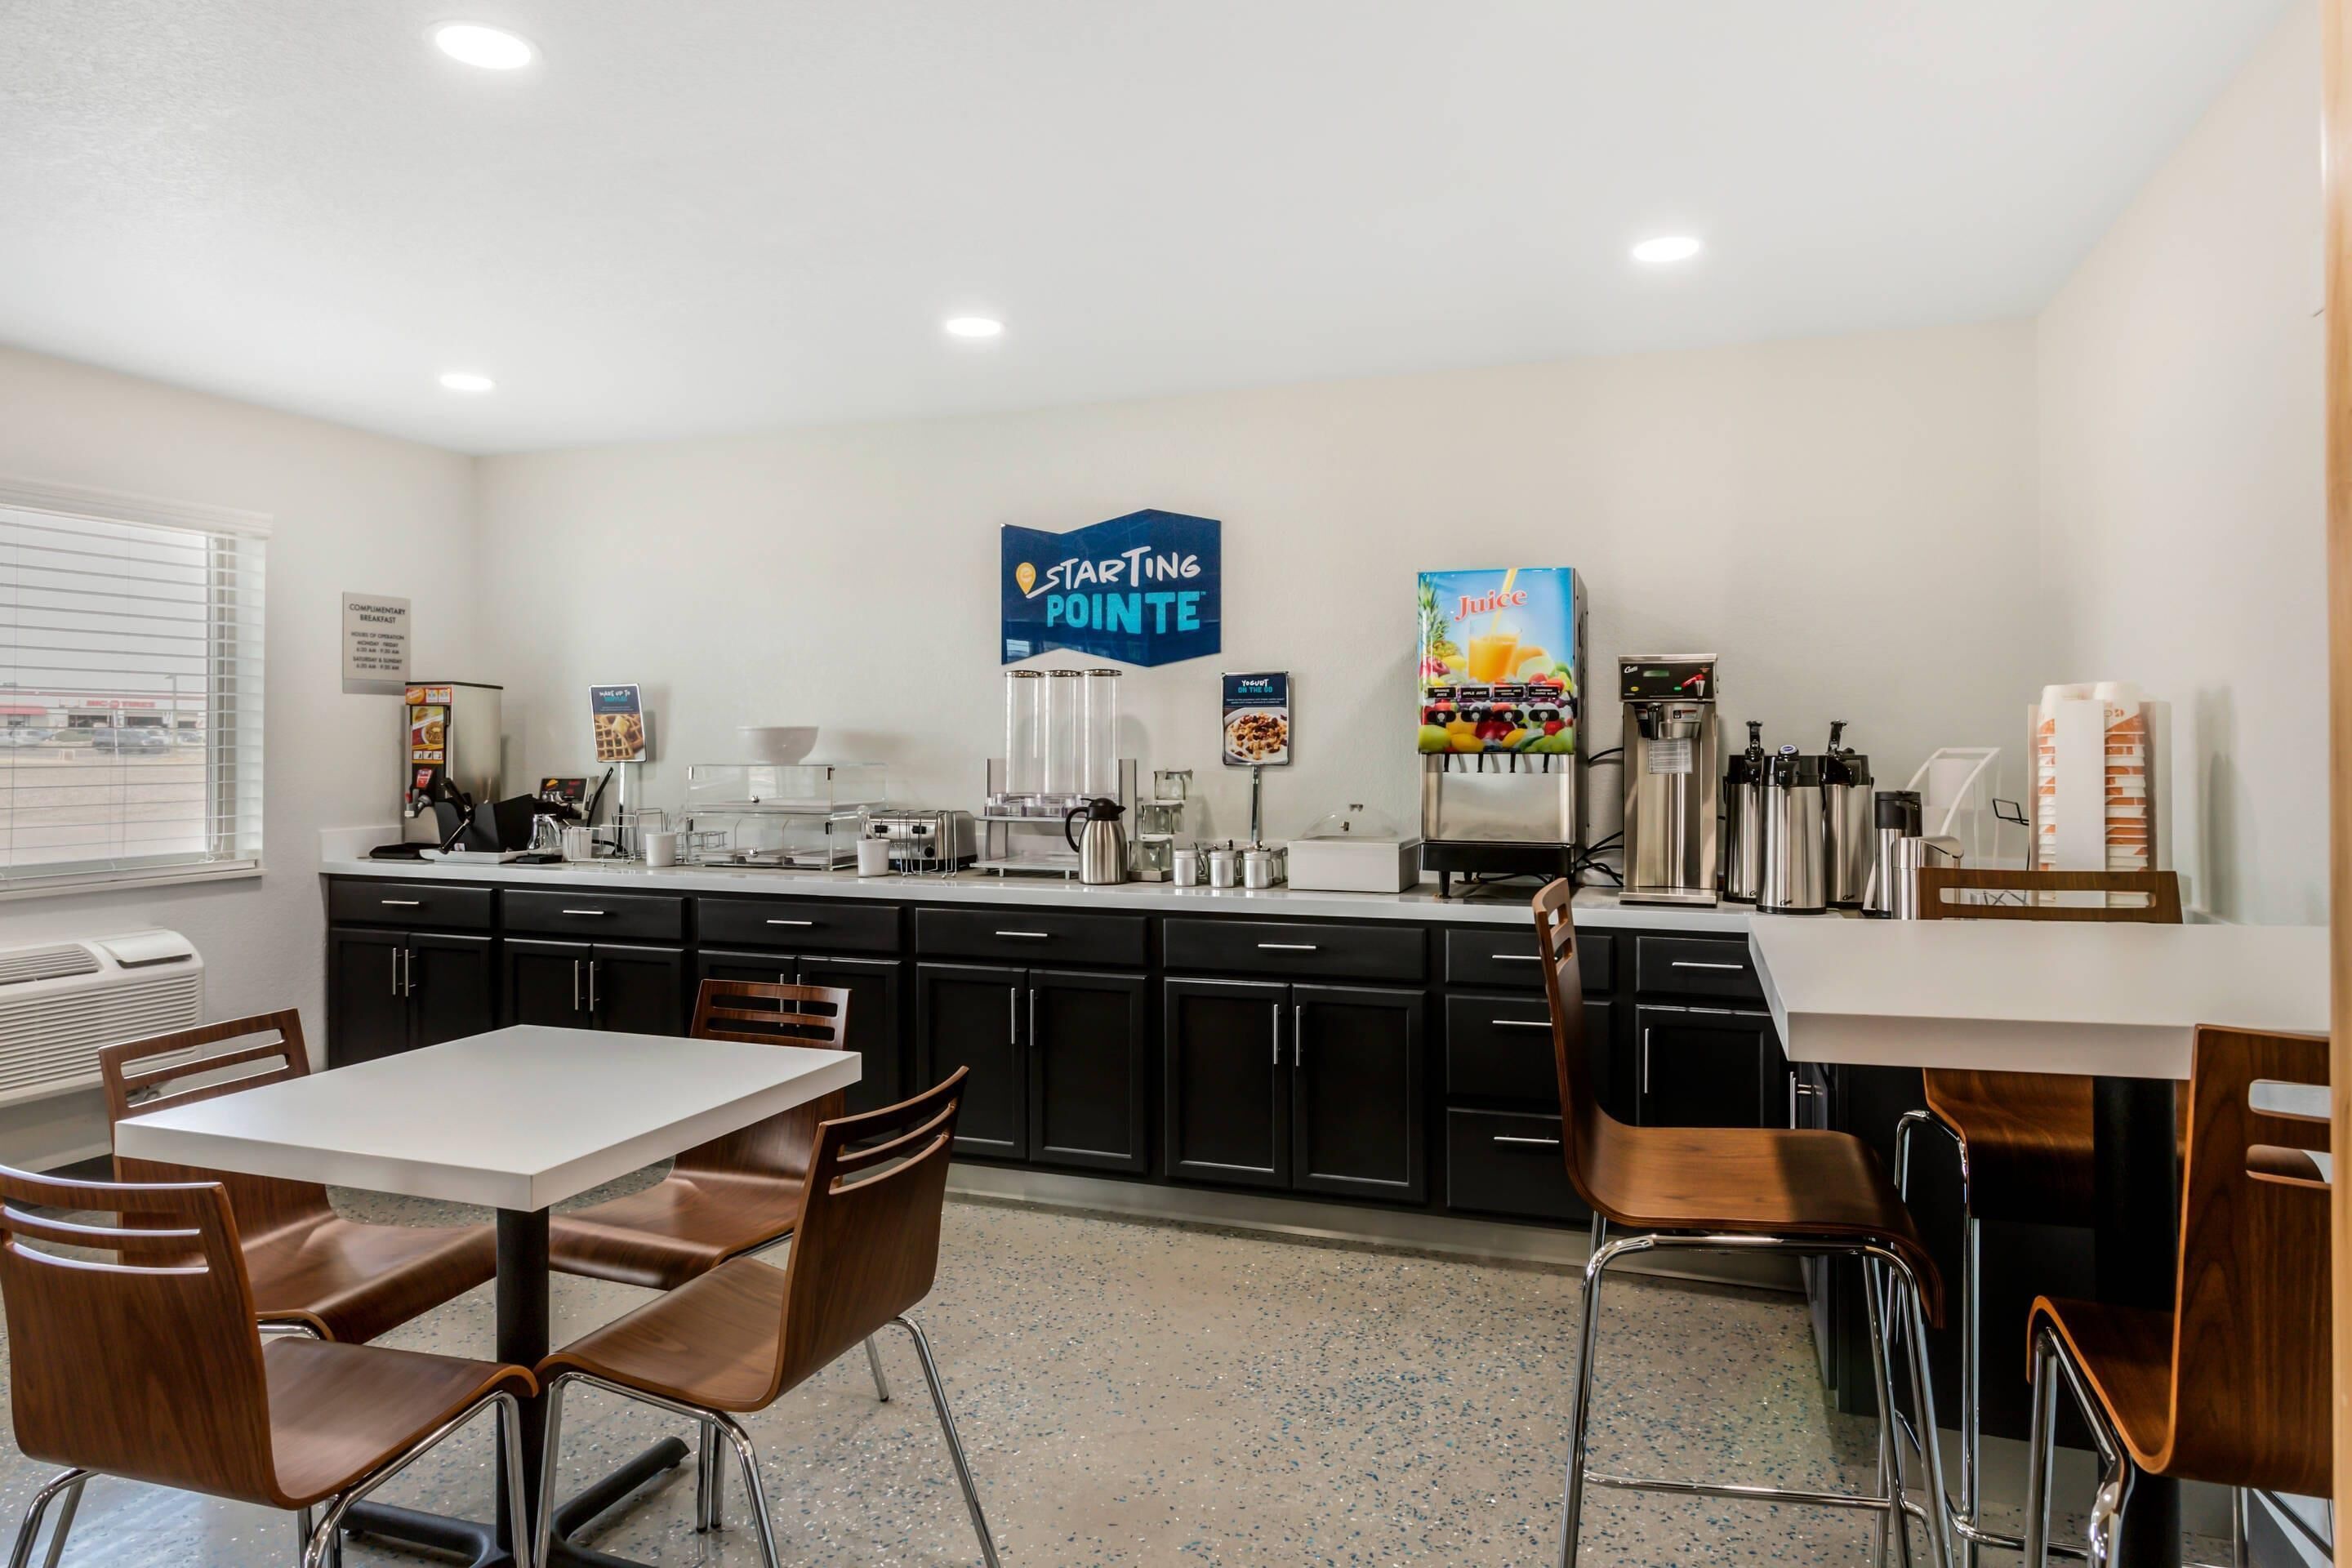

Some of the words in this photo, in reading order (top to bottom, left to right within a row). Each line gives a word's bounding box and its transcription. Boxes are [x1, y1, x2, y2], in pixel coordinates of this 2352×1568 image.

[1026, 546, 1201, 599] STARTING
[349, 604, 406, 615] COMPLIMENTARY
[1047, 591, 1200, 634] POINTE
[1454, 589, 1528, 621] Juice
[359, 614, 396, 624] BREAKFAST
[1241, 679, 1269, 688] YOGURT
